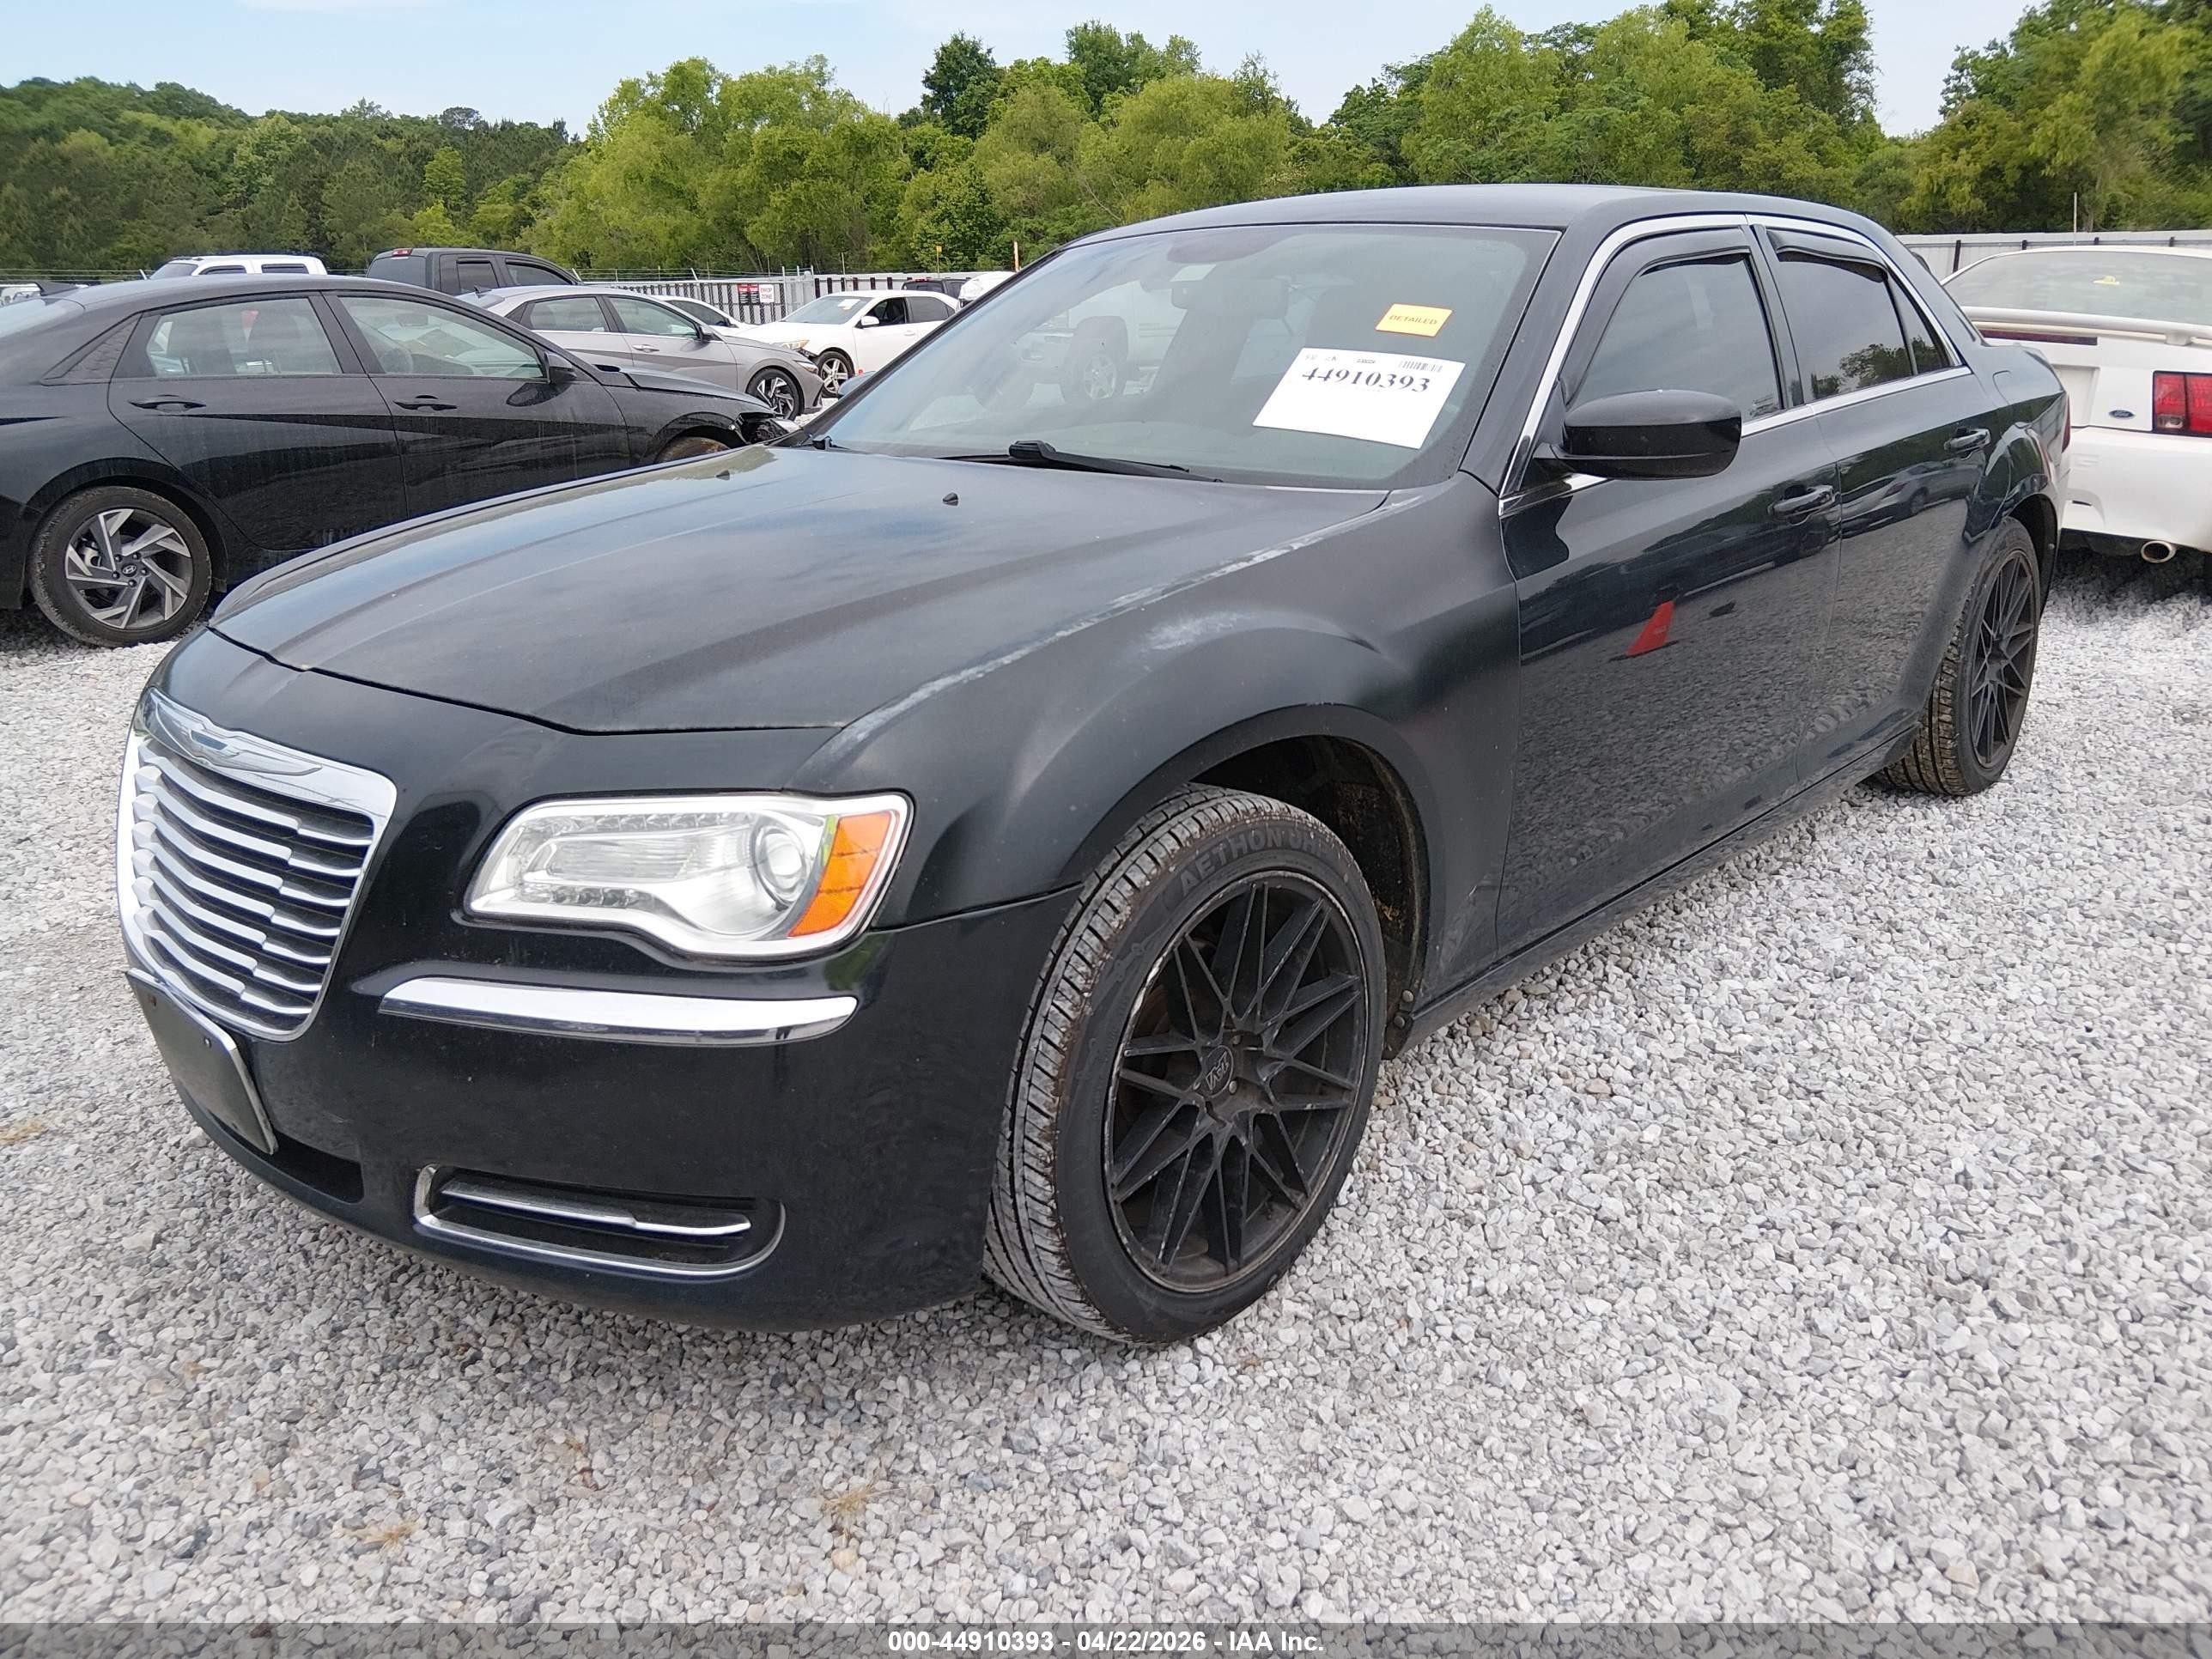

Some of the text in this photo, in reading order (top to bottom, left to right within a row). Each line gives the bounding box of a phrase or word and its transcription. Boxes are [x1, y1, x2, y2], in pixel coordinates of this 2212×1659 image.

[1389, 314, 1438, 325] DETAILED
[1302, 367, 1431, 392] 44910393
[1180, 825, 1285, 896] AETHON
